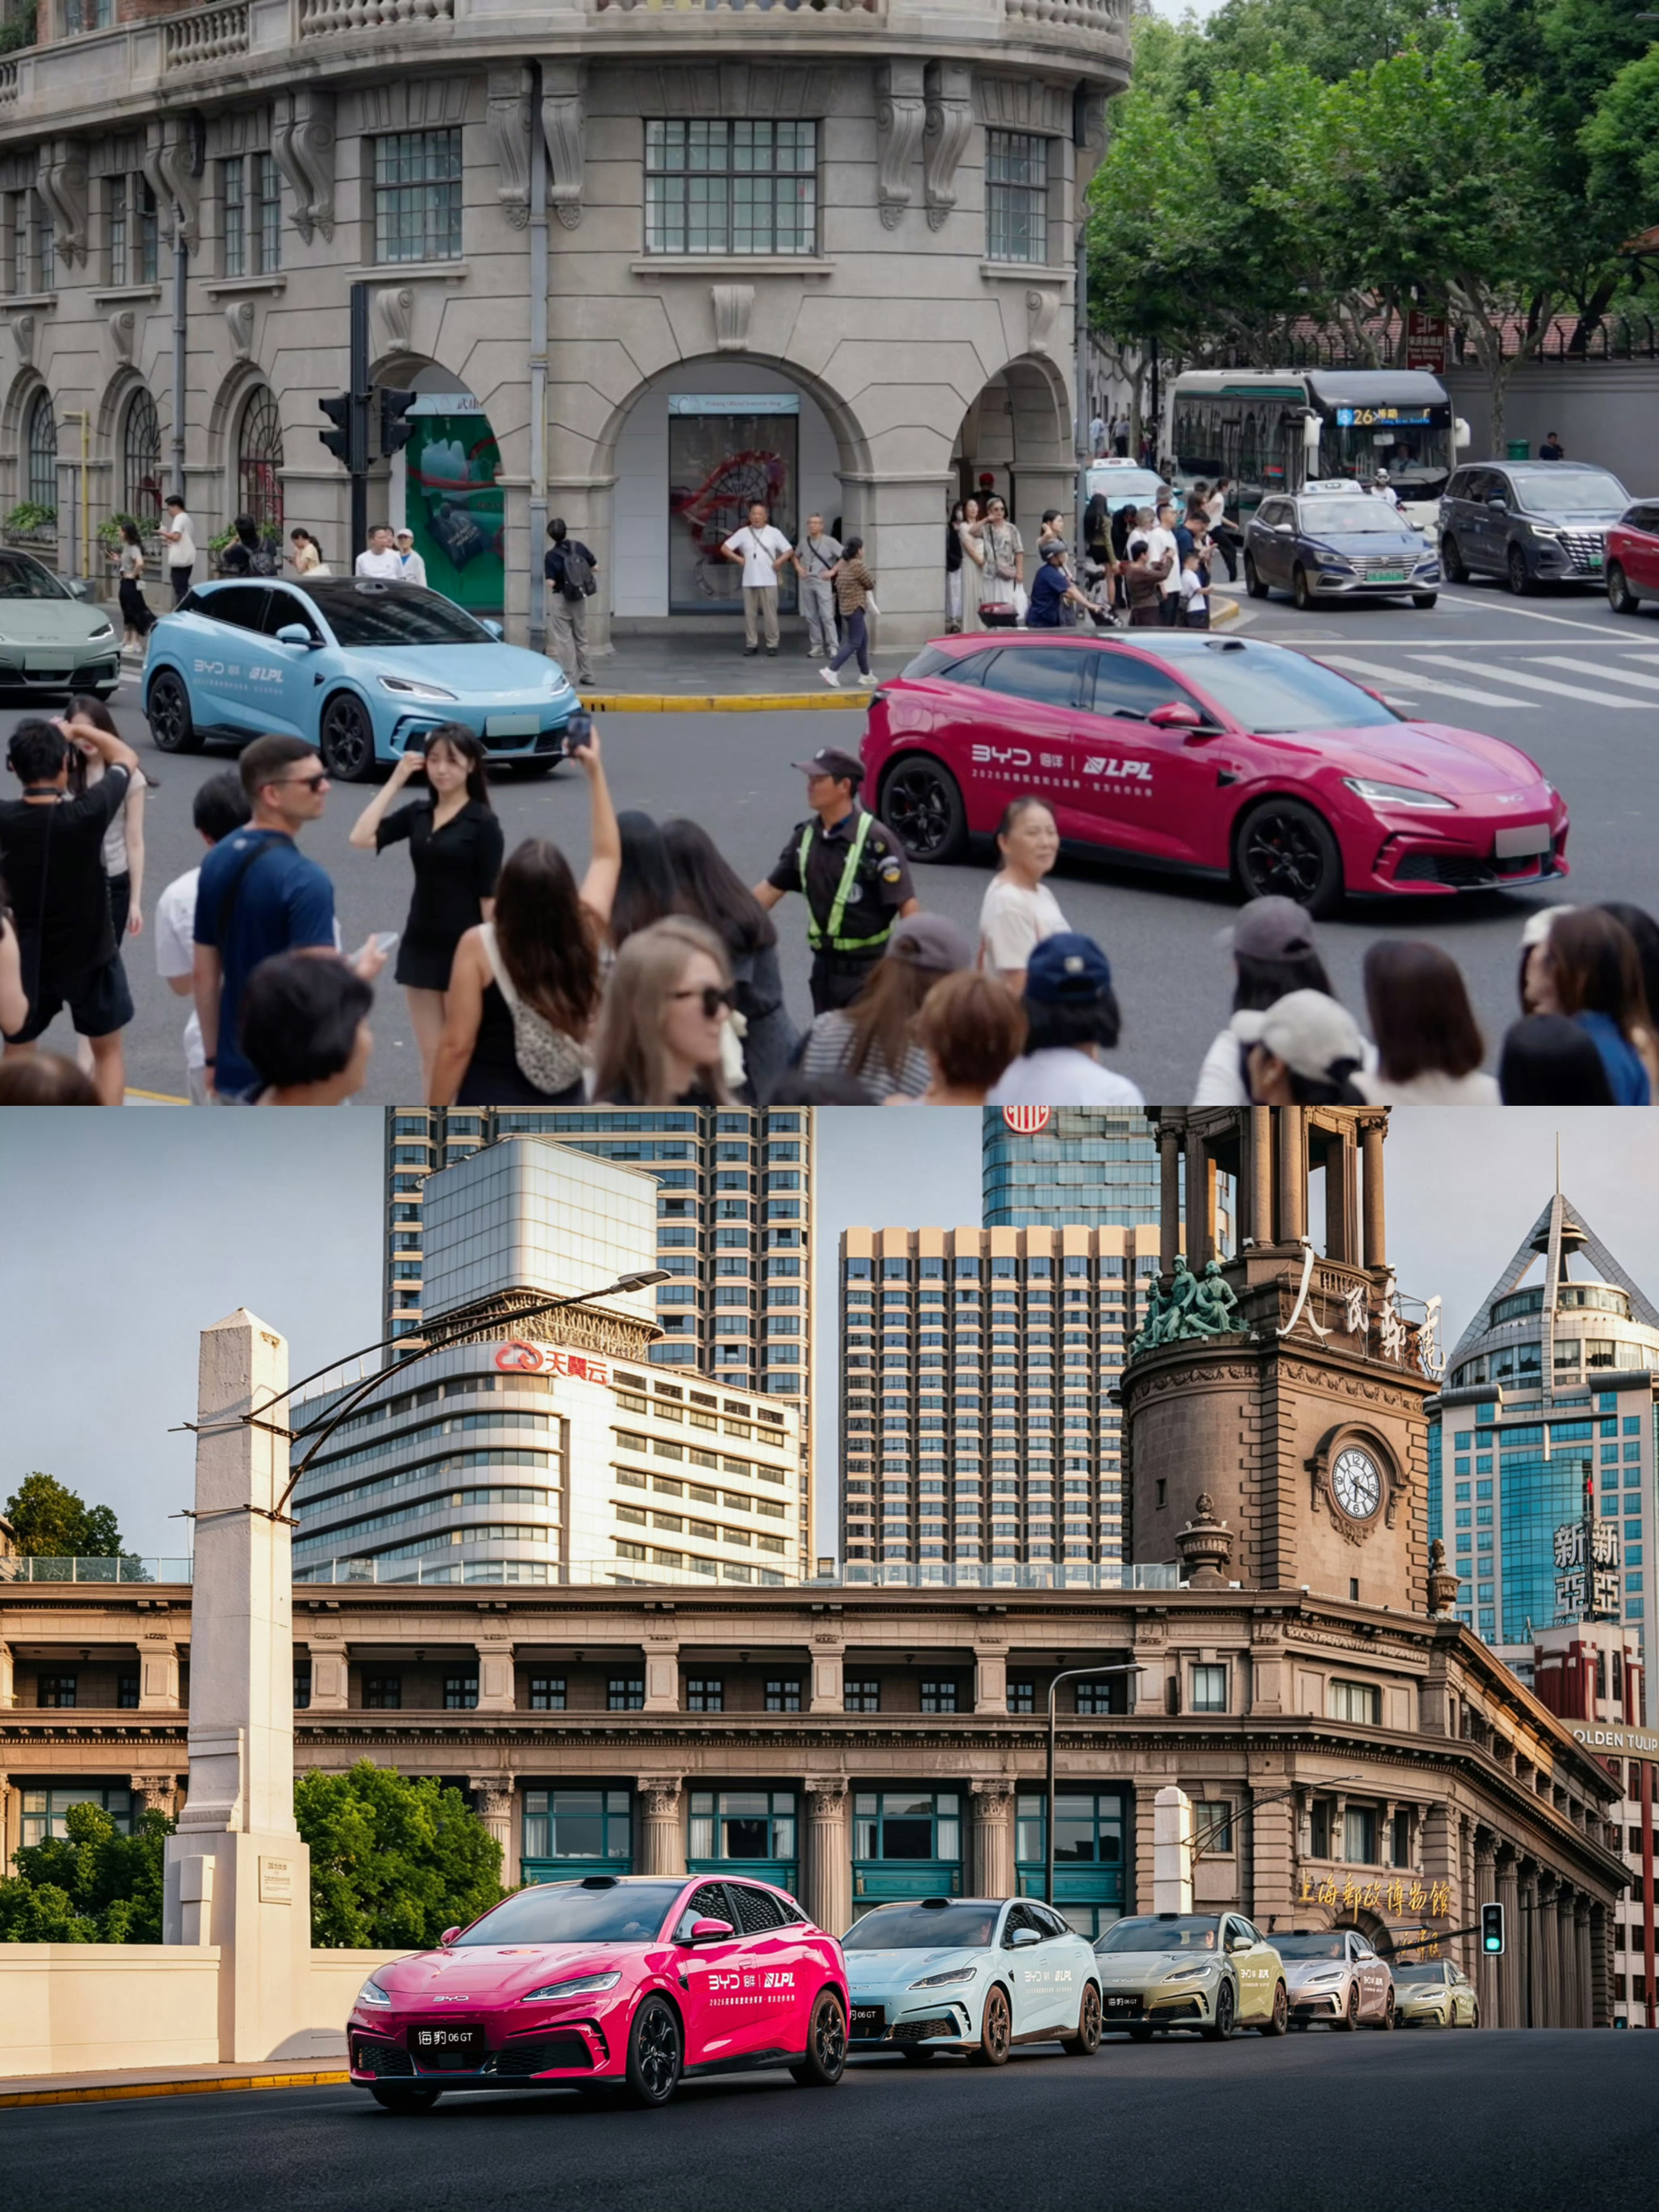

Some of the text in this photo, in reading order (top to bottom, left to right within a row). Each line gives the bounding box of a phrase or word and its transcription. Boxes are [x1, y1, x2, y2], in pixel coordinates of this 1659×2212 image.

[1353, 409, 1373, 424] 26
[194, 659, 224, 675] BYD
[260, 668, 283, 683] LPL
[972, 744, 1031, 766] BYD
[1105, 758, 1153, 780] LPL
[546, 1350, 608, 1385] 天翼云
[1352, 1455, 1360, 1465] 12
[1336, 1476, 1344, 1485] 9
[1370, 1483, 1376, 1493] 3
[1353, 1504, 1360, 1513] 6
[1626, 1734, 1658, 1752] TULIP
[708, 1974, 740, 1990] BYD
[774, 1972, 795, 1988] LPL
[1024, 1971, 1042, 1982] BYD
[418, 2031, 473, 2045] 海豹 06 GT
